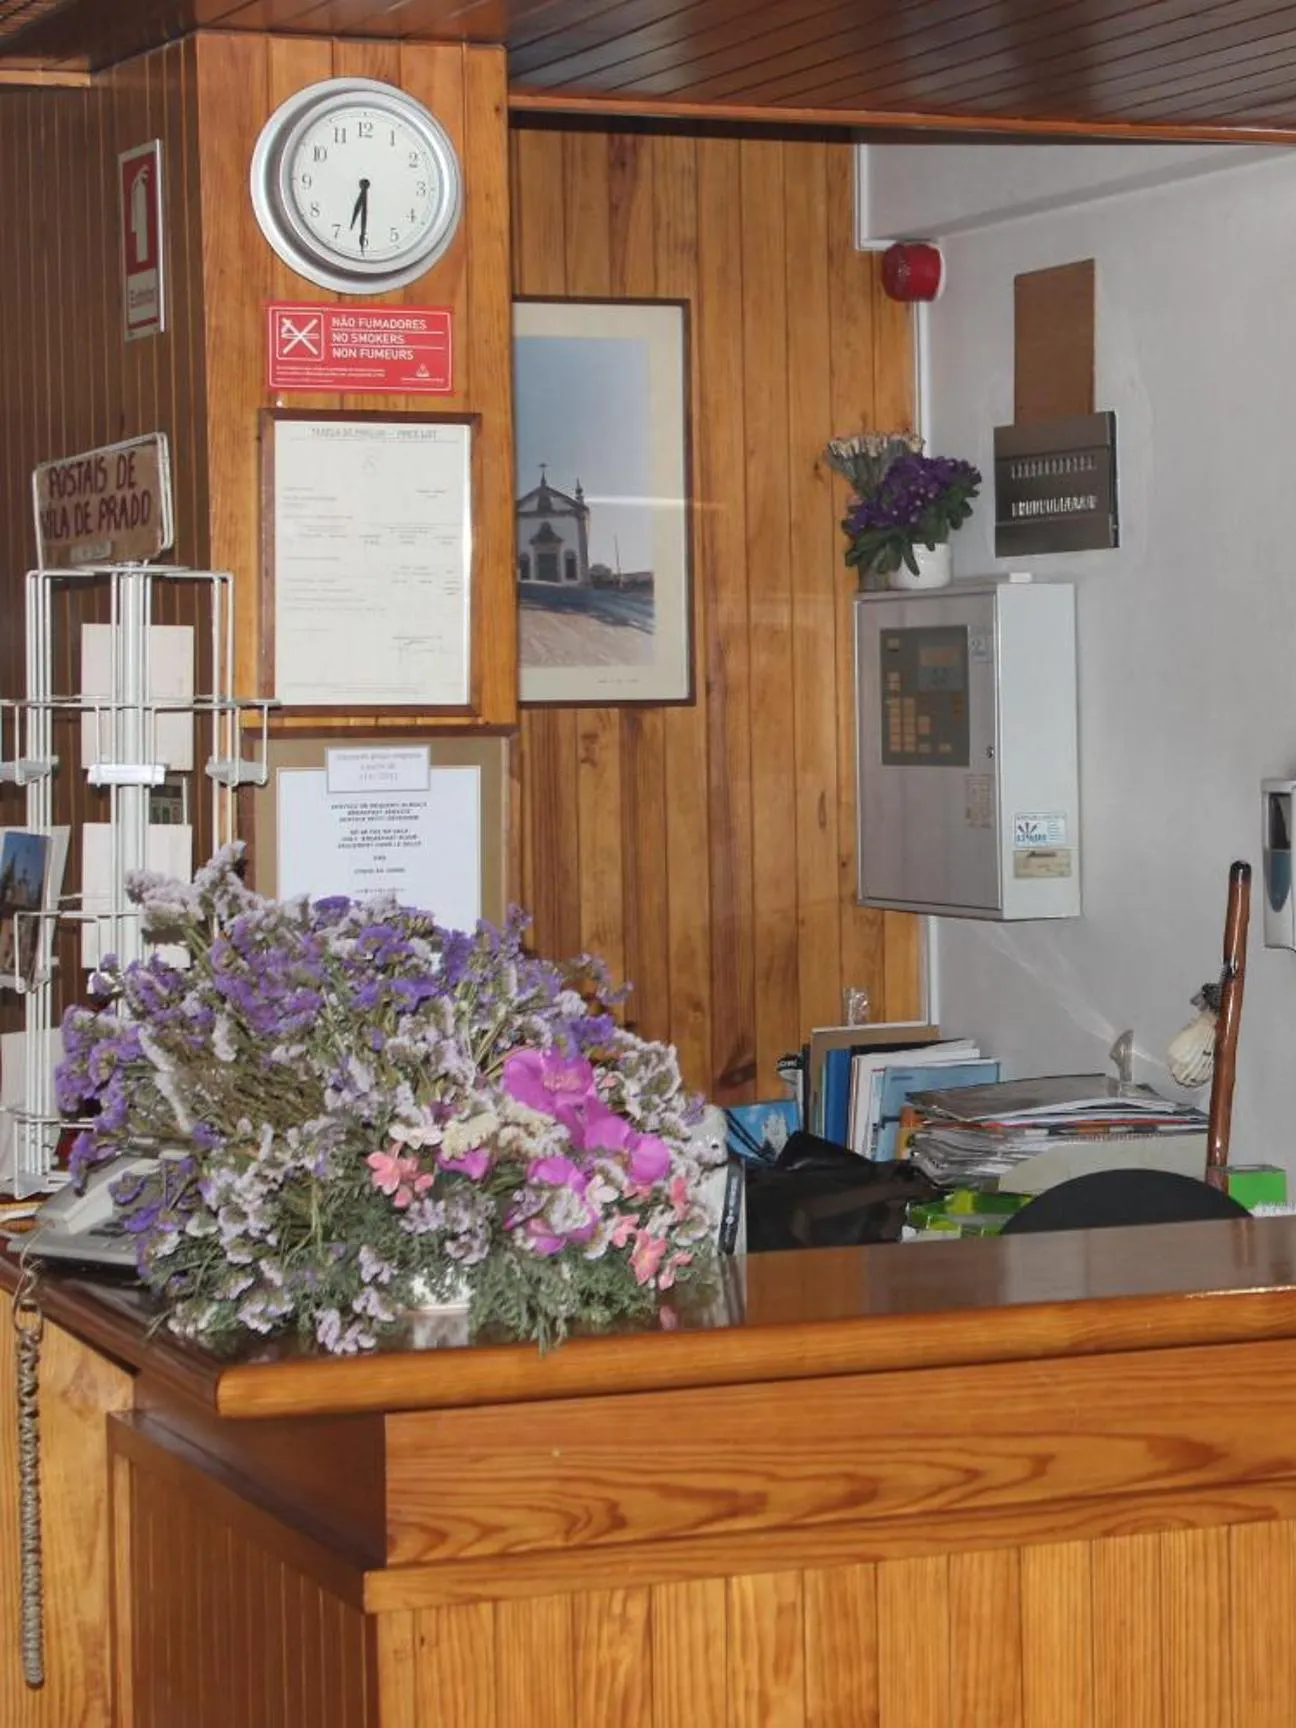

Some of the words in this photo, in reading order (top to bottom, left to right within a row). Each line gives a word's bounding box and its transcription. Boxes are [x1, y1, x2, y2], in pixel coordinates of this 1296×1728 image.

[334, 127, 347, 144] 11
[358, 121, 373, 138] 12
[389, 130, 396, 147] 1
[313, 146, 328, 163] 10
[408, 152, 419, 168] 2
[301, 174, 312, 190] 9
[416, 181, 426, 197] 3
[310, 202, 320, 218] 8
[406, 208, 416, 223] 4
[331, 223, 341, 239] 7
[390, 227, 399, 243] 5
[331, 314, 355, 328] NÃO
[358, 317, 428, 330] FUMADORES
[332, 333, 348, 343] NO
[350, 333, 406, 345] SMOKERS
[332, 347, 357, 359] NON
[359, 348, 414, 361] FUMEURS
[48, 455, 108, 500] POSTAIS
[116, 450, 137, 491] DE
[74, 500, 93, 537] DE
[98, 489, 152, 533] PRADO
